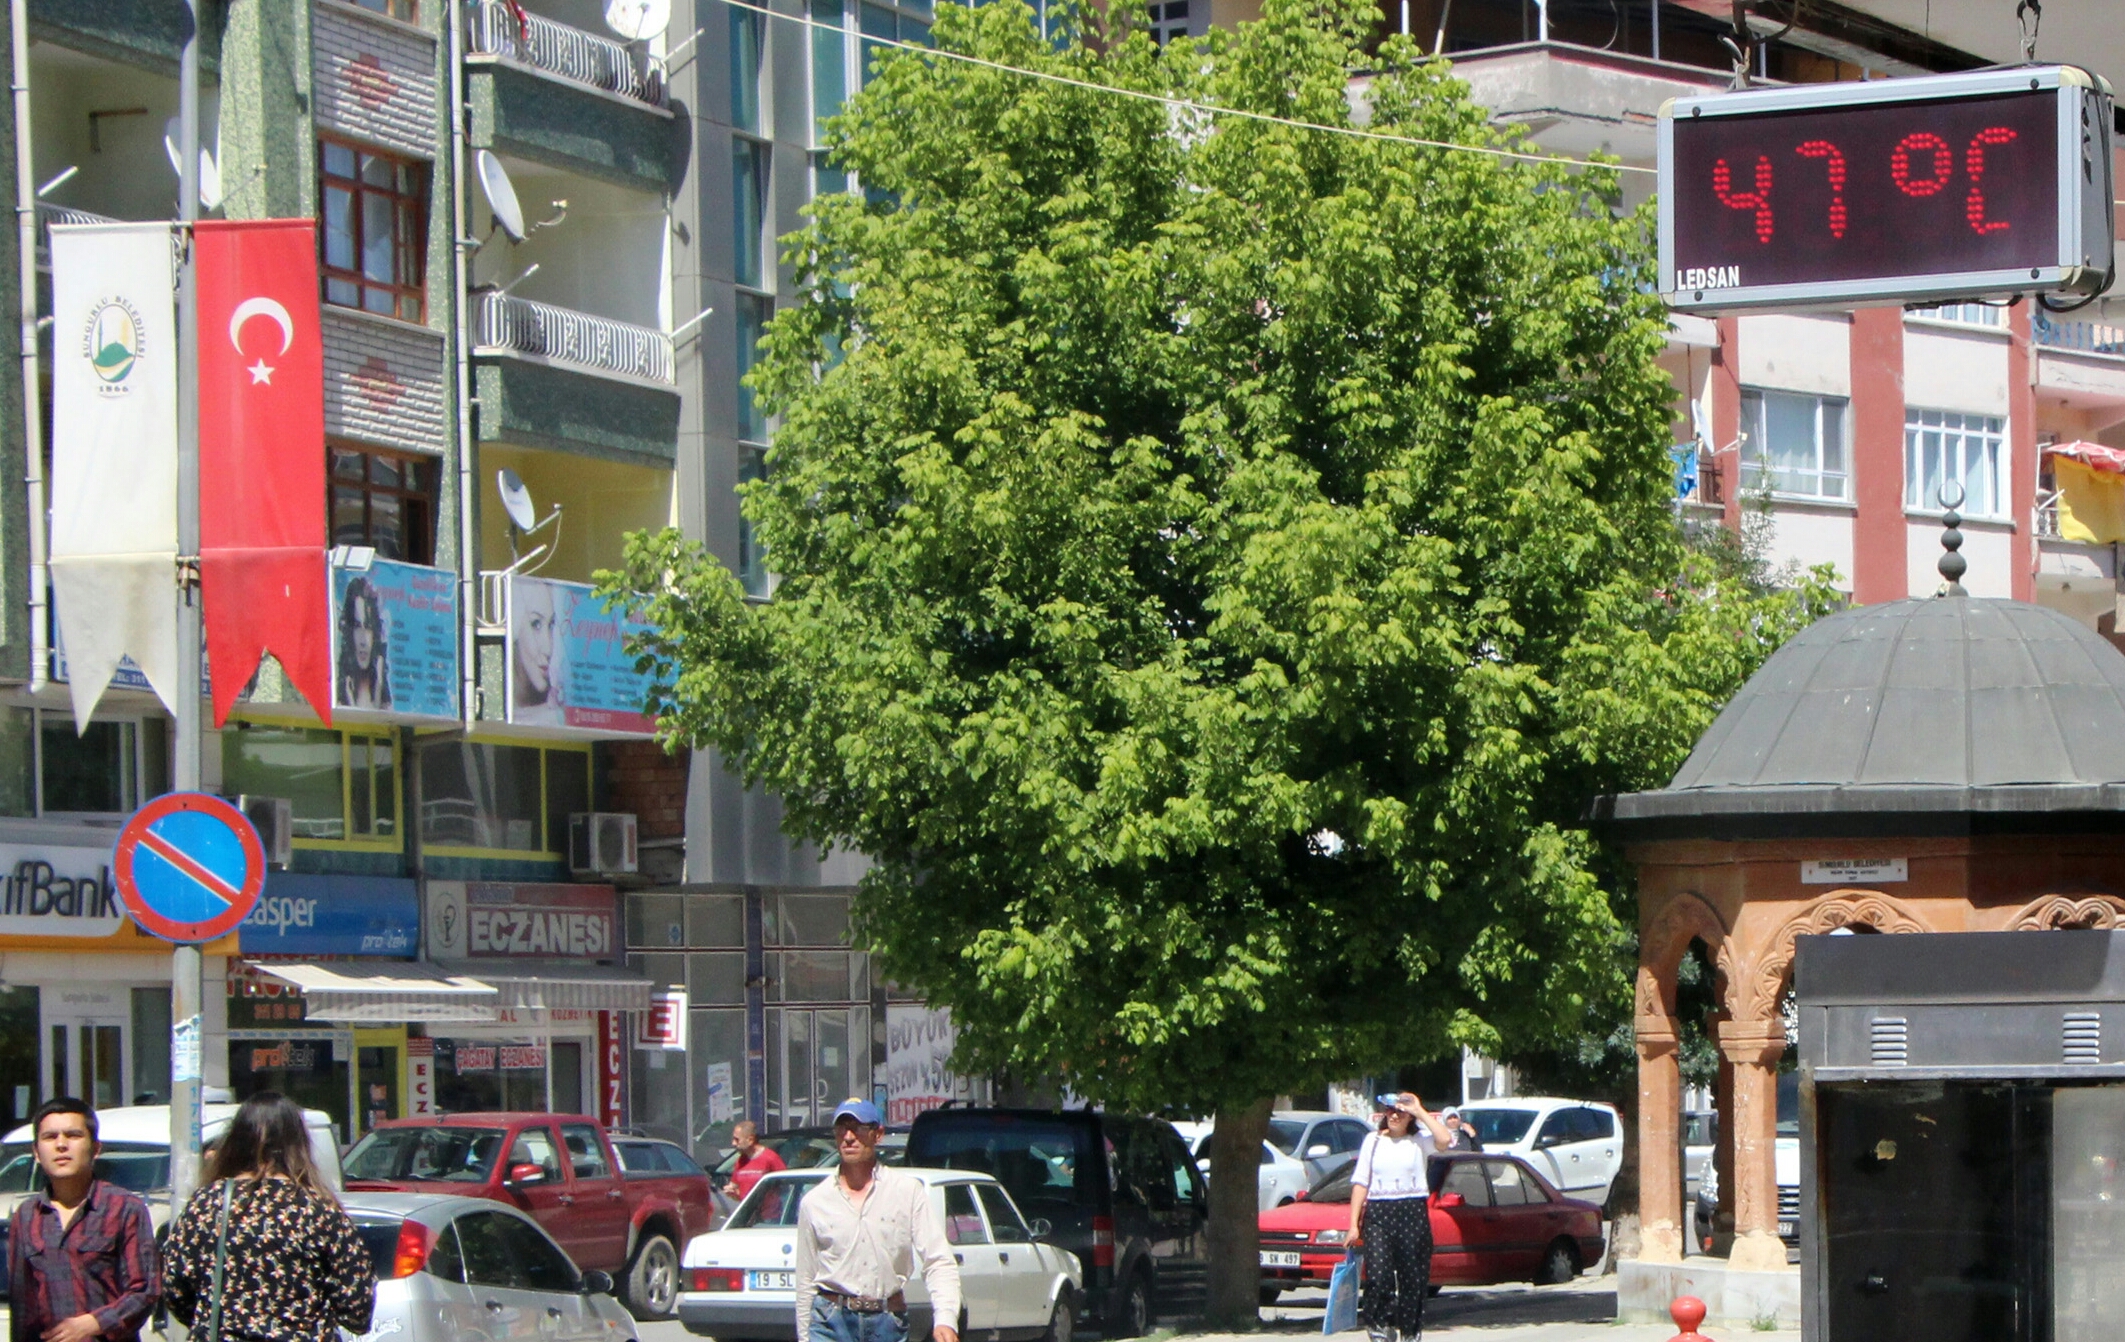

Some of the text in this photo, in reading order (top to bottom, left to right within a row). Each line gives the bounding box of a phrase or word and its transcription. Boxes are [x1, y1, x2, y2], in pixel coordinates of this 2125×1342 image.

[1677, 265, 1740, 291] LEDSAN
[0, 861, 119, 919] ıfBank
[455, 1042, 496, 1076] ÇAĞATAY
[756, 1273, 793, 1287] 19 SL
